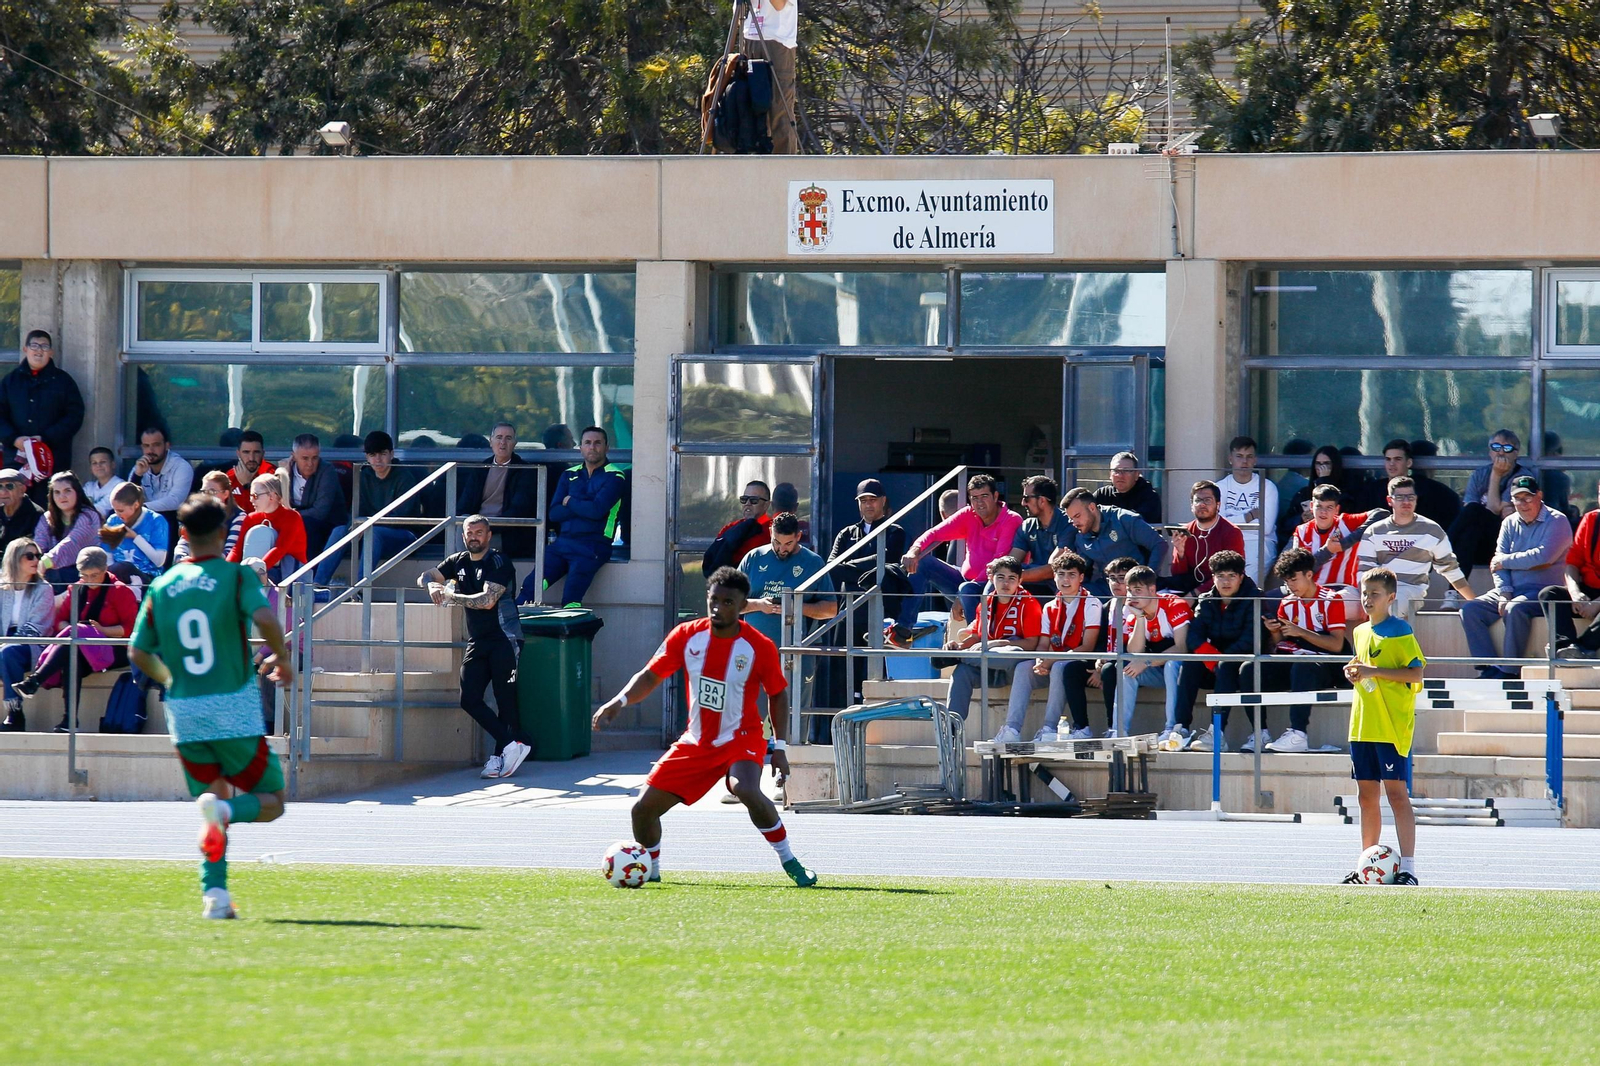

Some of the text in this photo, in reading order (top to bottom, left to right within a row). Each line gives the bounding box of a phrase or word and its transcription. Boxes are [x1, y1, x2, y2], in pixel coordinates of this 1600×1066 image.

[841, 188, 1049, 219] Excmo. Ayuntamiento
[893, 225, 996, 249] de Almería
[177, 608, 215, 676] 9
